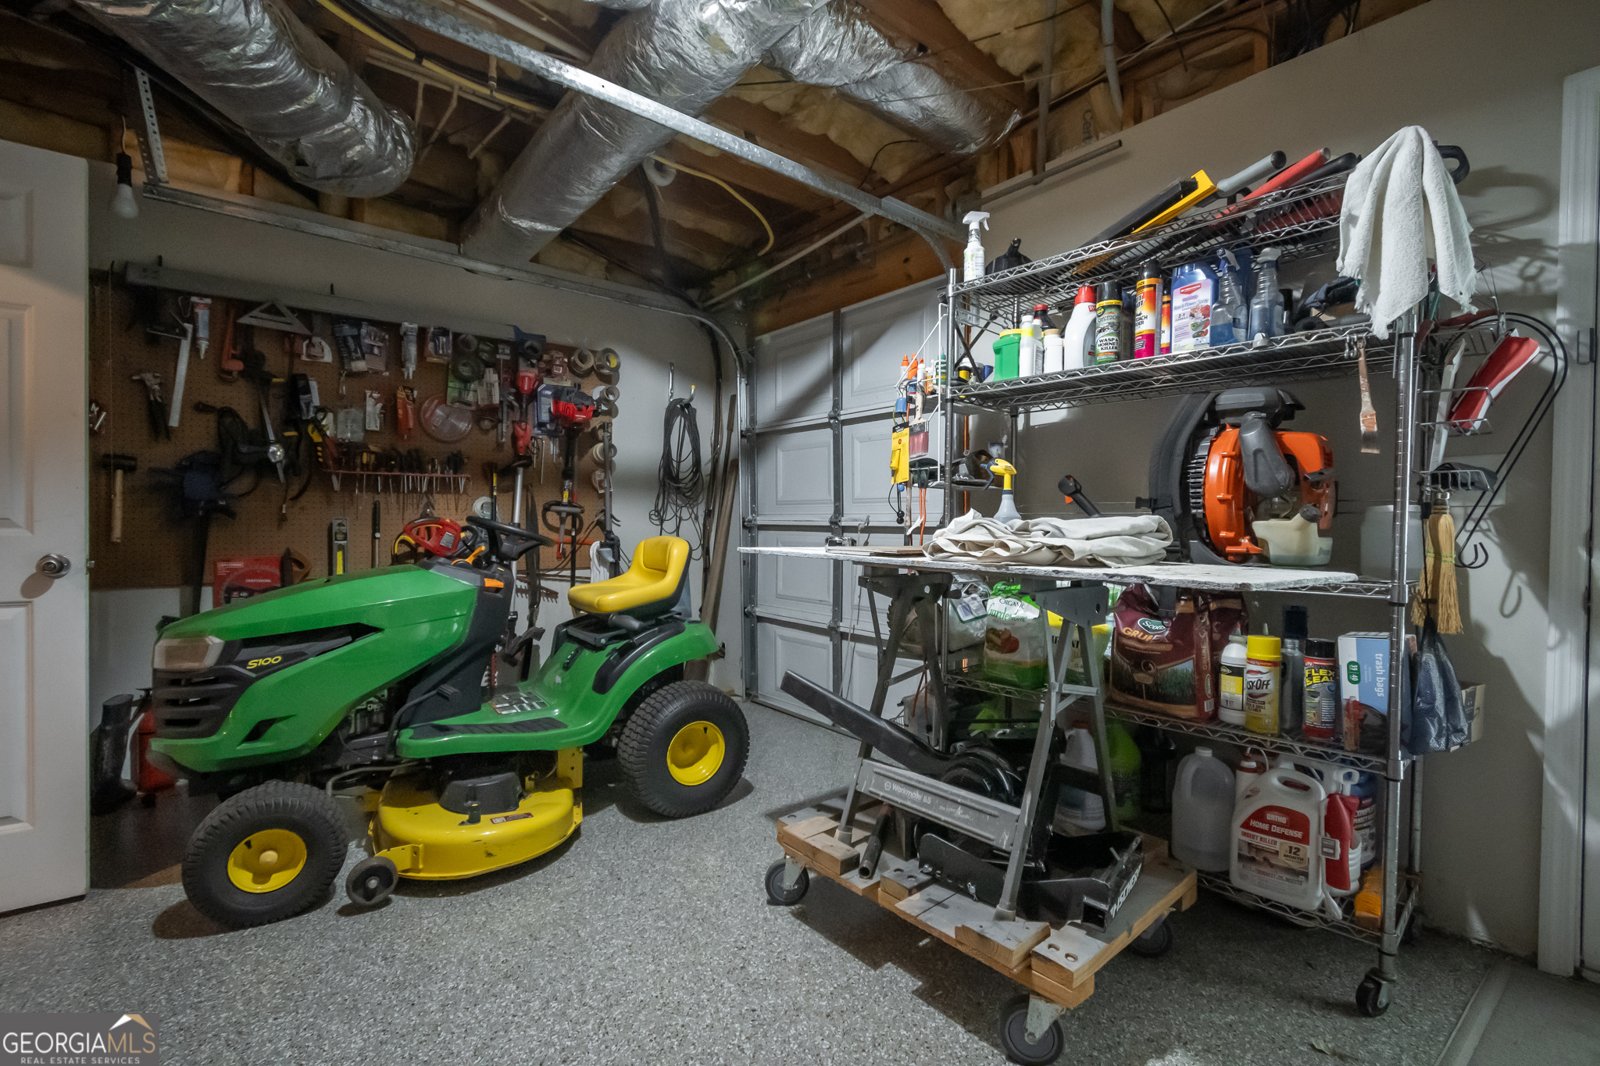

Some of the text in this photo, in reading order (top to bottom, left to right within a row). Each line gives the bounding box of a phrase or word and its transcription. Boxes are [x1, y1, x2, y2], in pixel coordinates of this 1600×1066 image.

[246, 655, 282, 669] S100
[1305, 668, 1335, 677] FLEX
[1374, 653, 1386, 697] trash bags
[1249, 818, 1304, 839] HOME DEFENSE
[1288, 845, 1301, 856] 12
